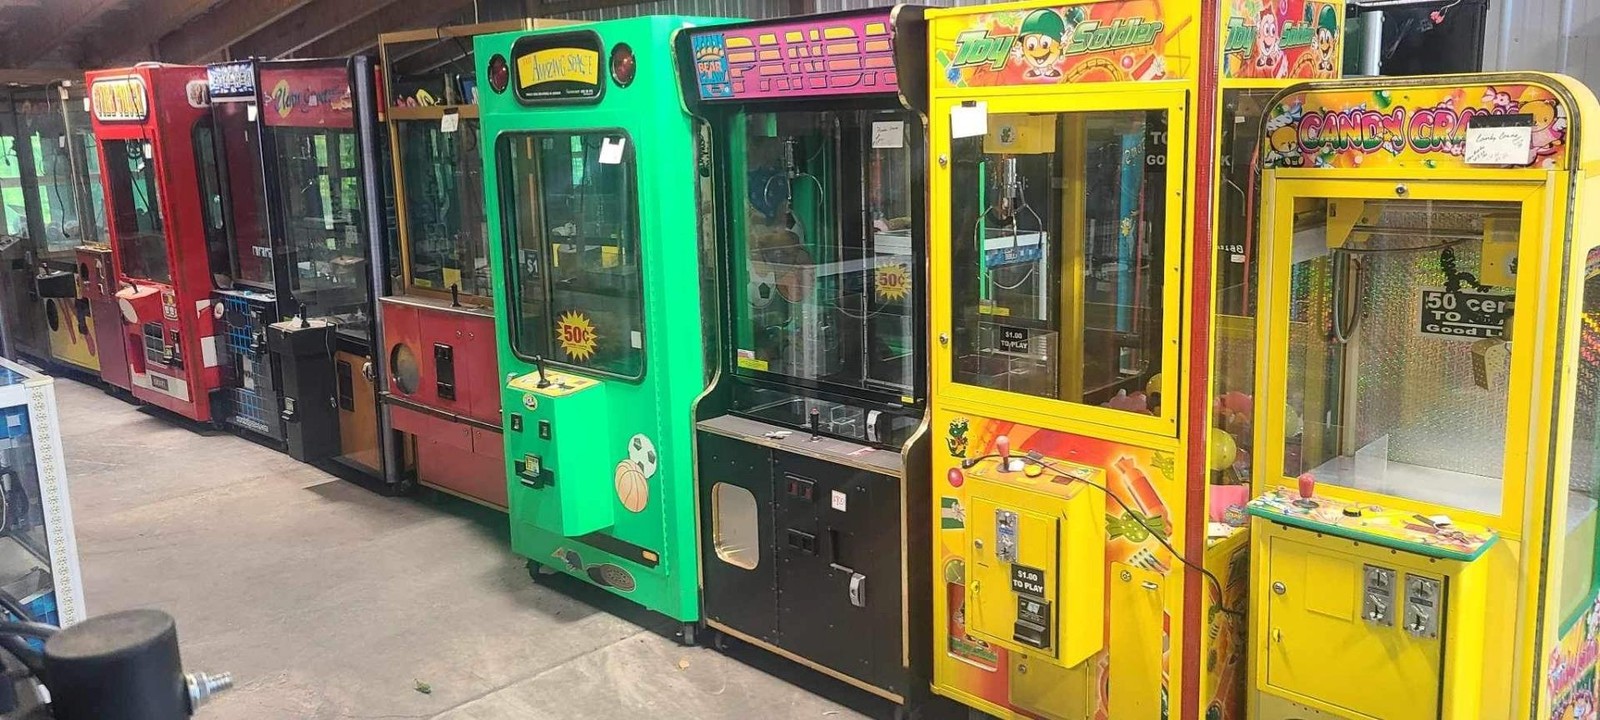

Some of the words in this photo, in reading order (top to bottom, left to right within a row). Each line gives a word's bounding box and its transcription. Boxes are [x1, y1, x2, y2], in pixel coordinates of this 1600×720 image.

[953, 30, 1018, 70] Toy
[1064, 18, 1164, 54] Soldier
[1224, 16, 1256, 59] Toy
[725, 22, 897, 93] PANDA
[1299, 106, 1405, 152] CANDY
[879, 273, 905, 287] 50¢
[1427, 292, 1457, 310] 50
[1431, 310, 1461, 322] TO
[563, 324, 590, 344] 50¢
[1005, 331, 1023, 339] $1.00
[1426, 323, 1478, 336] Good
[1010, 341, 1028, 349] PLAY
[1017, 569, 1038, 581] $1.00
[1013, 579, 1023, 588] TO
[1024, 581, 1044, 593] PLAY
